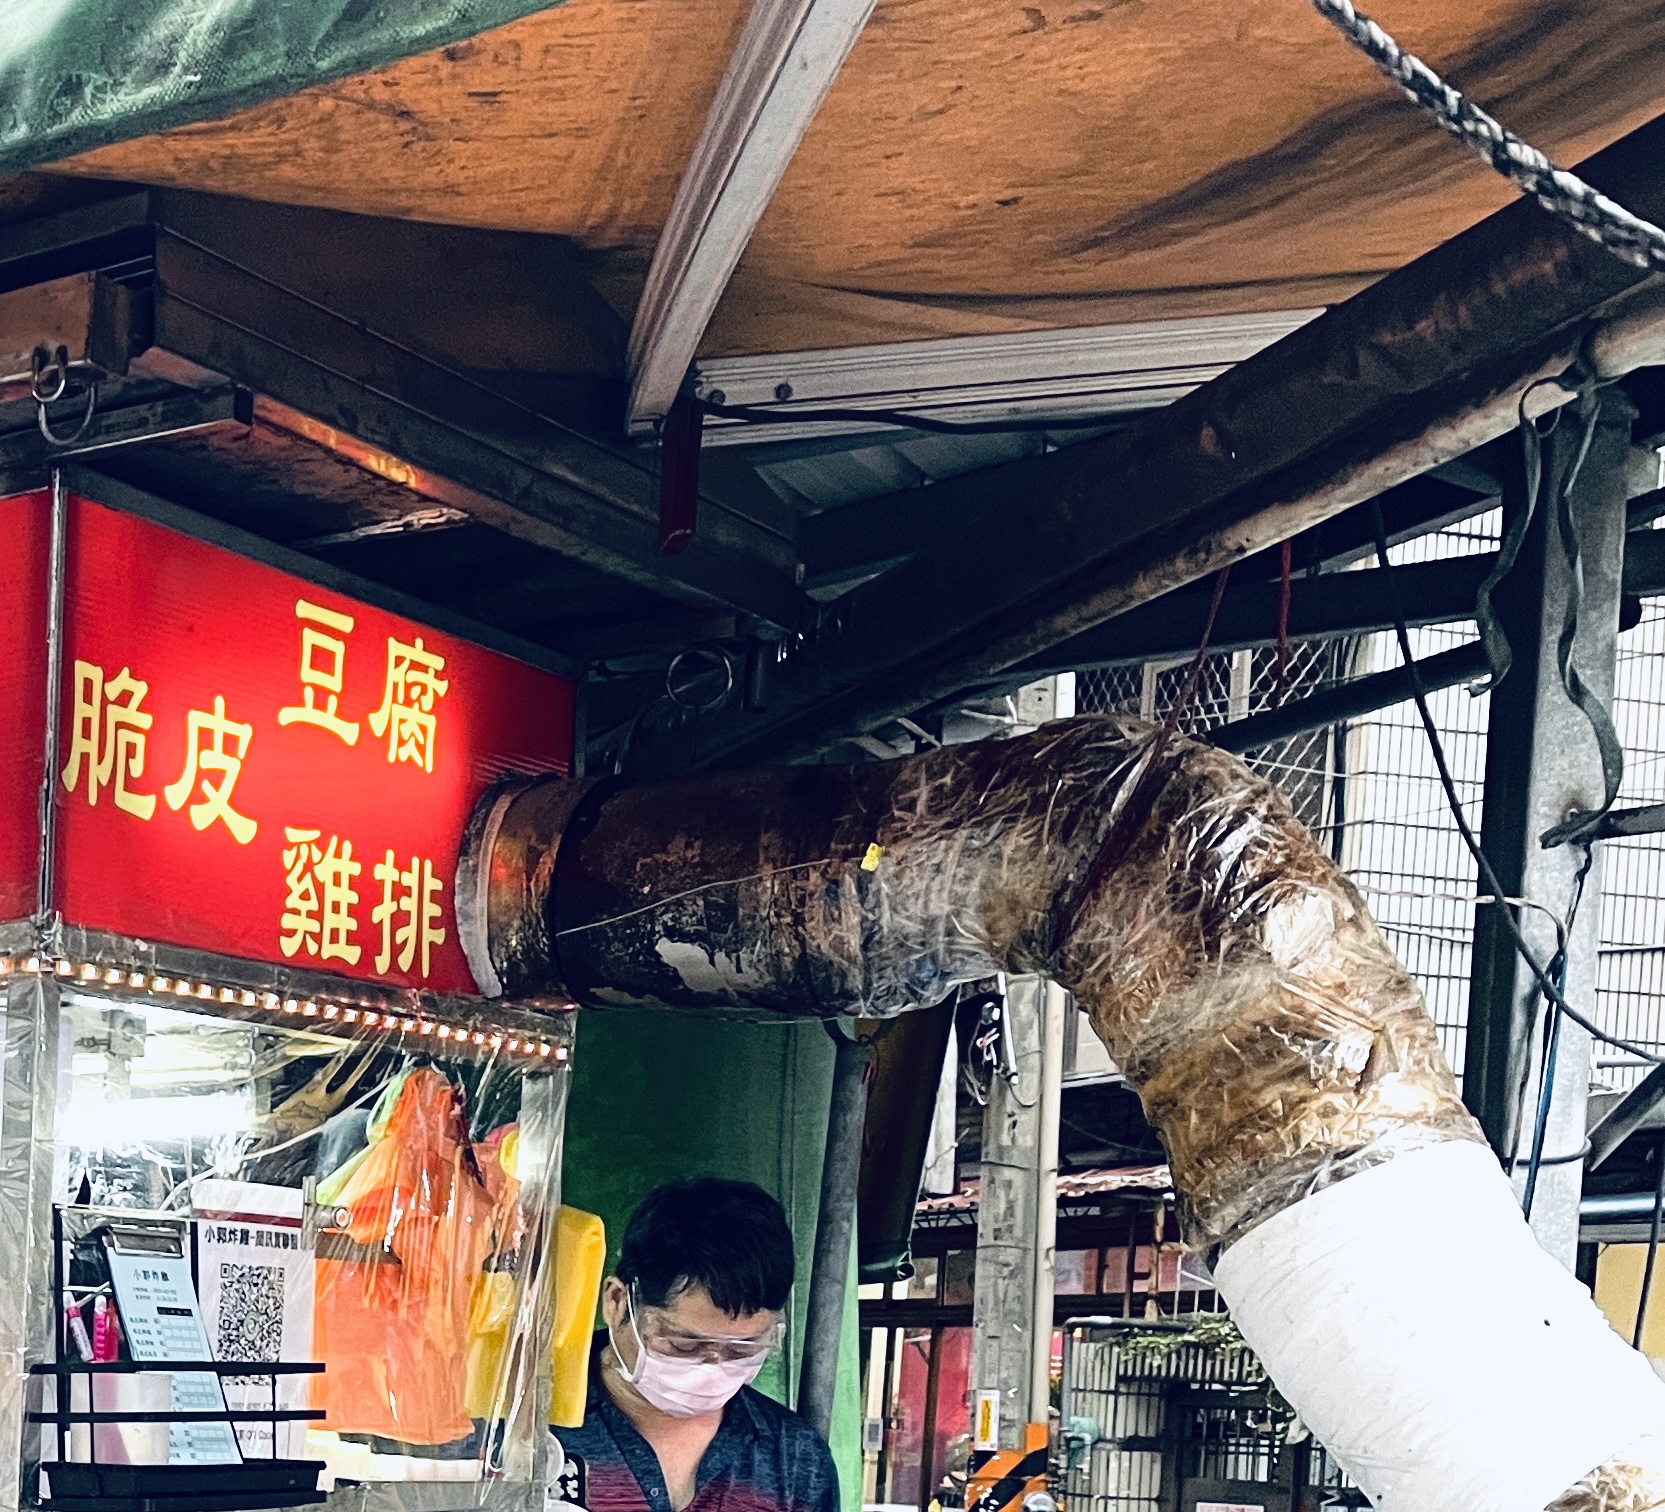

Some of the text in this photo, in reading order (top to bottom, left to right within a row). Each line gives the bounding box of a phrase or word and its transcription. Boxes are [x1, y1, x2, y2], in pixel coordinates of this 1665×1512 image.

[62, 659, 258, 845] 脆皮
[277, 598, 449, 774] 豆腐
[278, 826, 446, 978] 雞排
